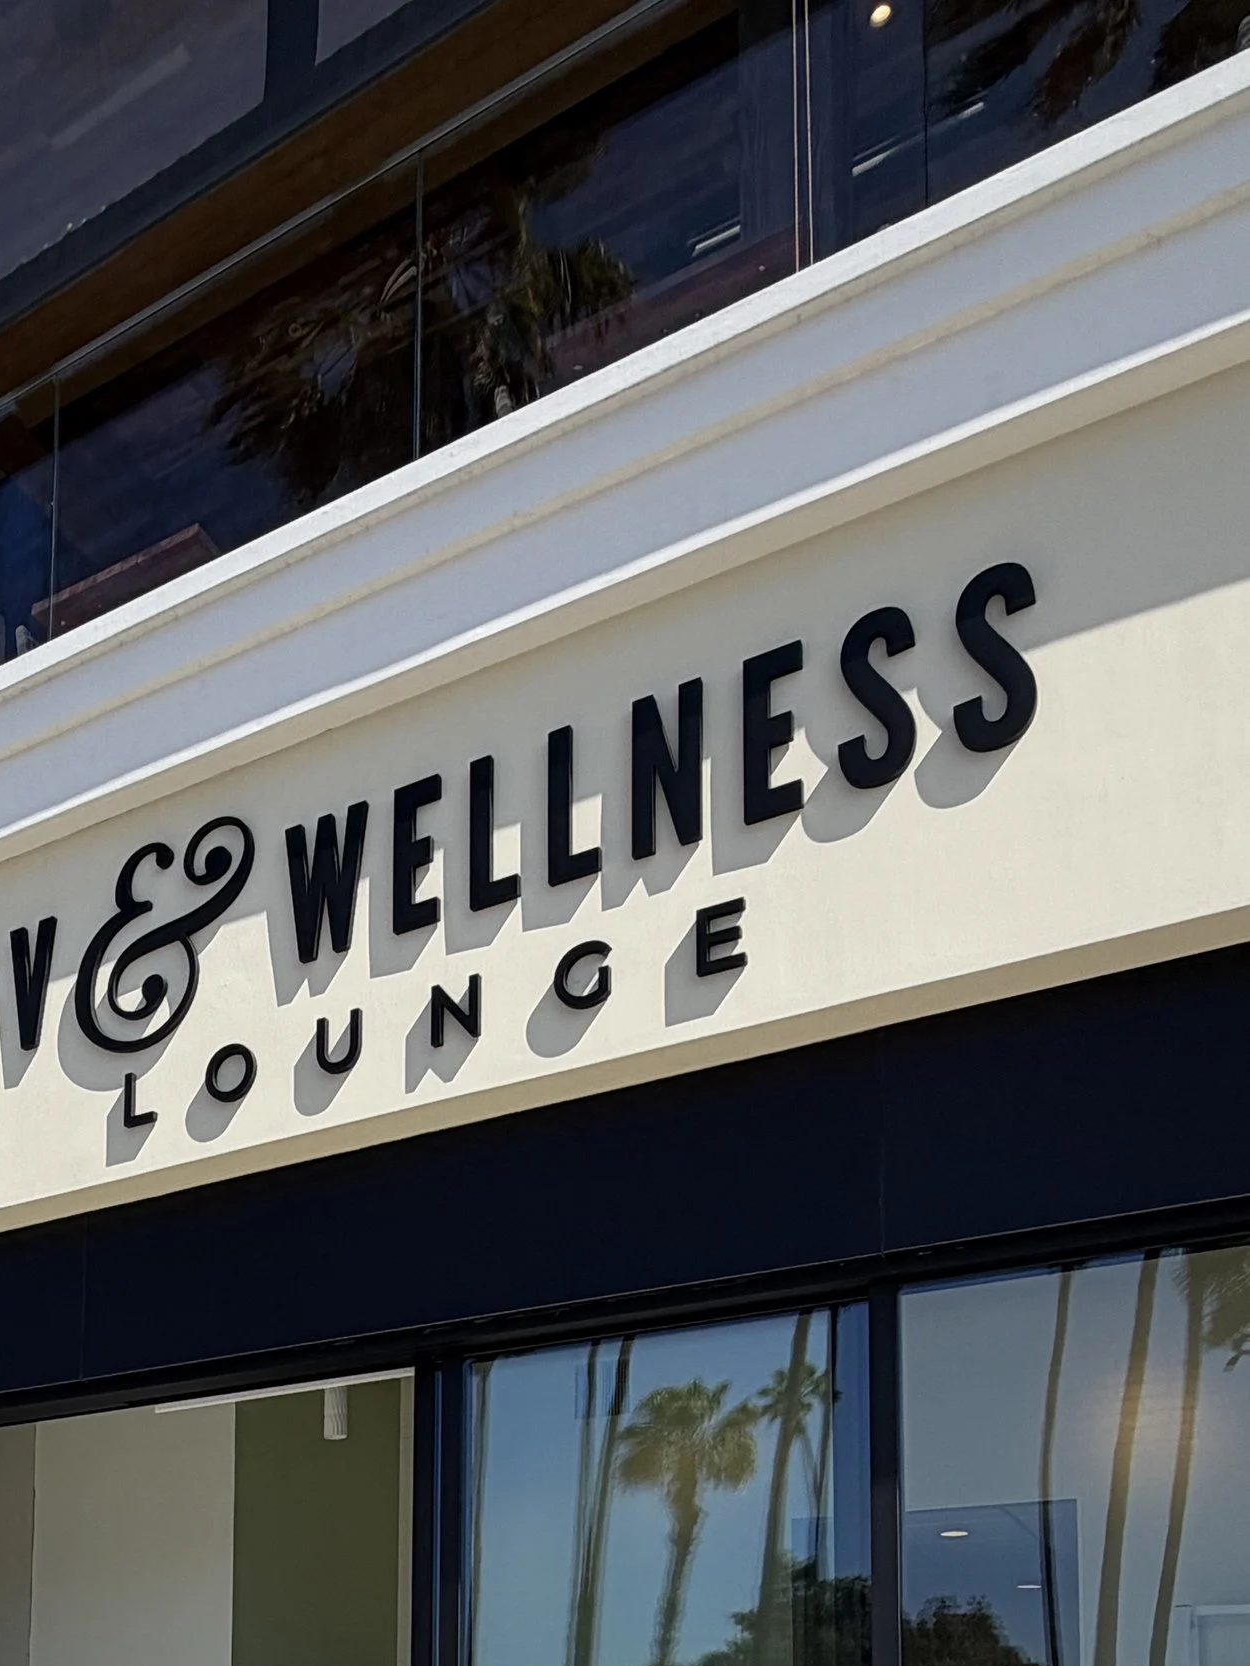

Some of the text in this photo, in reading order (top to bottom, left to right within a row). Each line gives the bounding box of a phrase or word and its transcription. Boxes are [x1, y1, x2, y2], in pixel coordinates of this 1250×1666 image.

[75, 815, 256, 1054] &
[284, 562, 1038, 965] WELLNESS
[124, 897, 748, 1129] LOUNGE
